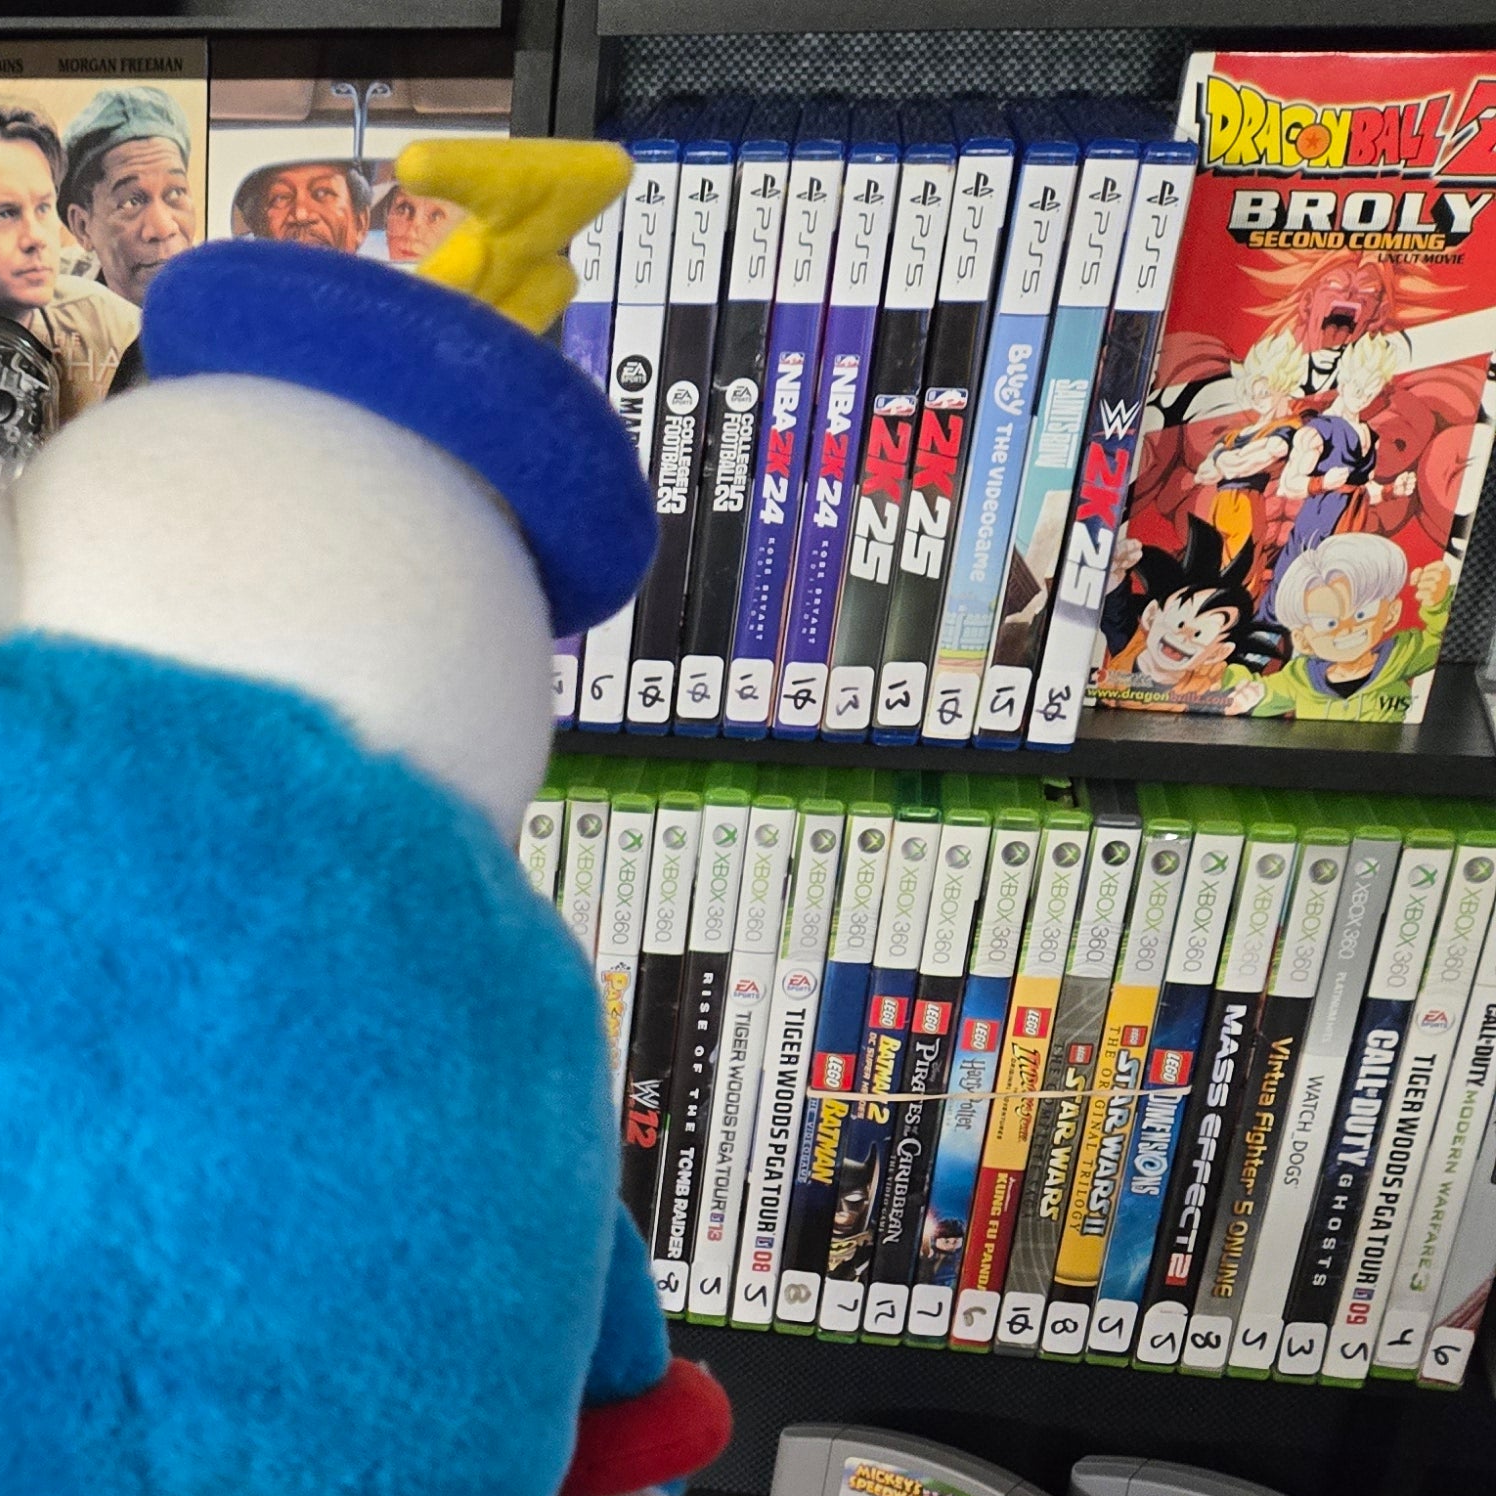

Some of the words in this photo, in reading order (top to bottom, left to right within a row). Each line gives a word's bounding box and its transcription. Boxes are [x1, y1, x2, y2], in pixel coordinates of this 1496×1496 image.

[57, 58, 116, 75] MORGAN
[120, 58, 183, 75] FREEMAN
[1227, 190, 1494, 233] BROLY
[636, 212, 656, 283] PS5
[688, 210, 709, 282] PS5
[749, 208, 772, 279] PS5
[794, 210, 818, 282] PS5
[851, 213, 875, 284] PS5
[906, 215, 931, 287] PS5
[1249, 231, 1346, 249] SECOND
[1348, 232, 1446, 251] COMING
[1378, 252, 1422, 264] UNCUT
[1424, 253, 1465, 264] MOVIE
[773, 364, 803, 431] NBA
[827, 365, 860, 435] NBA
[659, 416, 683, 487] FOOTBALL
[673, 415, 695, 488] COLLEGE
[716, 413, 741, 487] FOOTBALL
[729, 412, 754, 490] COLLEGE
[760, 428, 795, 525] 2K24
[657, 485, 687, 514] 25
[713, 485, 745, 511] 25
[814, 432, 849, 528] 2K24
[850, 415, 912, 584] 2K25
[901, 410, 963, 579] 2K25
[1061, 444, 1130, 610] 2K25
[1378, 695, 1412, 710] VHS
[615, 857, 638, 908] XBOX
[660, 854, 681, 905] XBOX
[939, 873, 964, 926] XBOX
[611, 909, 632, 945] 360
[654, 907, 675, 943] 360
[1190, 881, 1218, 934] XBOX
[932, 928, 955, 965] 360
[1182, 936, 1207, 973] 360
[697, 971, 715, 1032] RISE
[880, 998, 898, 1027] LEGO
[922, 1002, 941, 1032] LEGO
[1022, 1009, 1040, 1036] LEGO
[693, 1045, 705, 1075] OF
[729, 1010, 752, 1064] TIGER
[778, 1008, 806, 1067] TIGER
[970, 1021, 990, 1050] LEGO
[1207, 1004, 1248, 1107] MASS
[1354, 1029, 1399, 1090] CALL
[722, 1062, 747, 1128] WOODS
[827, 1055, 844, 1087] LEGO
[1105, 1051, 1139, 1134] STAR
[1258, 1037, 1294, 1106] Virtua
[1404, 1054, 1437, 1111] TIGER
[685, 1087, 700, 1134] THE
[769, 1069, 798, 1145] WOODS
[1052, 1067, 1086, 1144] STAR
[1335, 1096, 1383, 1168] DUTY
[1441, 1089, 1480, 1174] MODERN
[713, 1130, 736, 1170] PGA
[763, 1145, 787, 1181] PGA
[811, 1097, 849, 1185] BATMAN
[1241, 1111, 1275, 1194] Fighter
[1382, 1114, 1421, 1194] WOODS
[674, 1147, 695, 1198] TOMB
[709, 1170, 733, 1218] TOUR
[988, 1173, 1009, 1217] KUNG
[1039, 1148, 1073, 1222] WARS
[1069, 1159, 1095, 1233] TRILOGY
[1088, 1135, 1123, 1217] WARS
[1175, 1113, 1222, 1253] EFFECT
[667, 1198, 691, 1259] RAIDER
[707, 1223, 723, 1242] 13
[755, 1181, 780, 1233] TOUR
[986, 1219, 1002, 1241] FU
[1232, 1200, 1253, 1215] 5
[1312, 1173, 1353, 1287] GHOSTS
[1370, 1193, 1398, 1232] PGA
[1418, 1182, 1451, 1271] WARFARE
[752, 1251, 772, 1273] 08
[1212, 1220, 1249, 1298] ONLINE
[1356, 1234, 1389, 1285] TOUR
[1409, 1271, 1424, 1291] 3
[917, 1301, 943, 1318] 7
[1050, 1317, 1079, 1334] 8
[1098, 1315, 1124, 1340] 5
[1346, 1302, 1371, 1325] 09
[1150, 1332, 1176, 1354] 5
[1190, 1331, 1221, 1349] 8
[1340, 1342, 1368, 1362] 5
